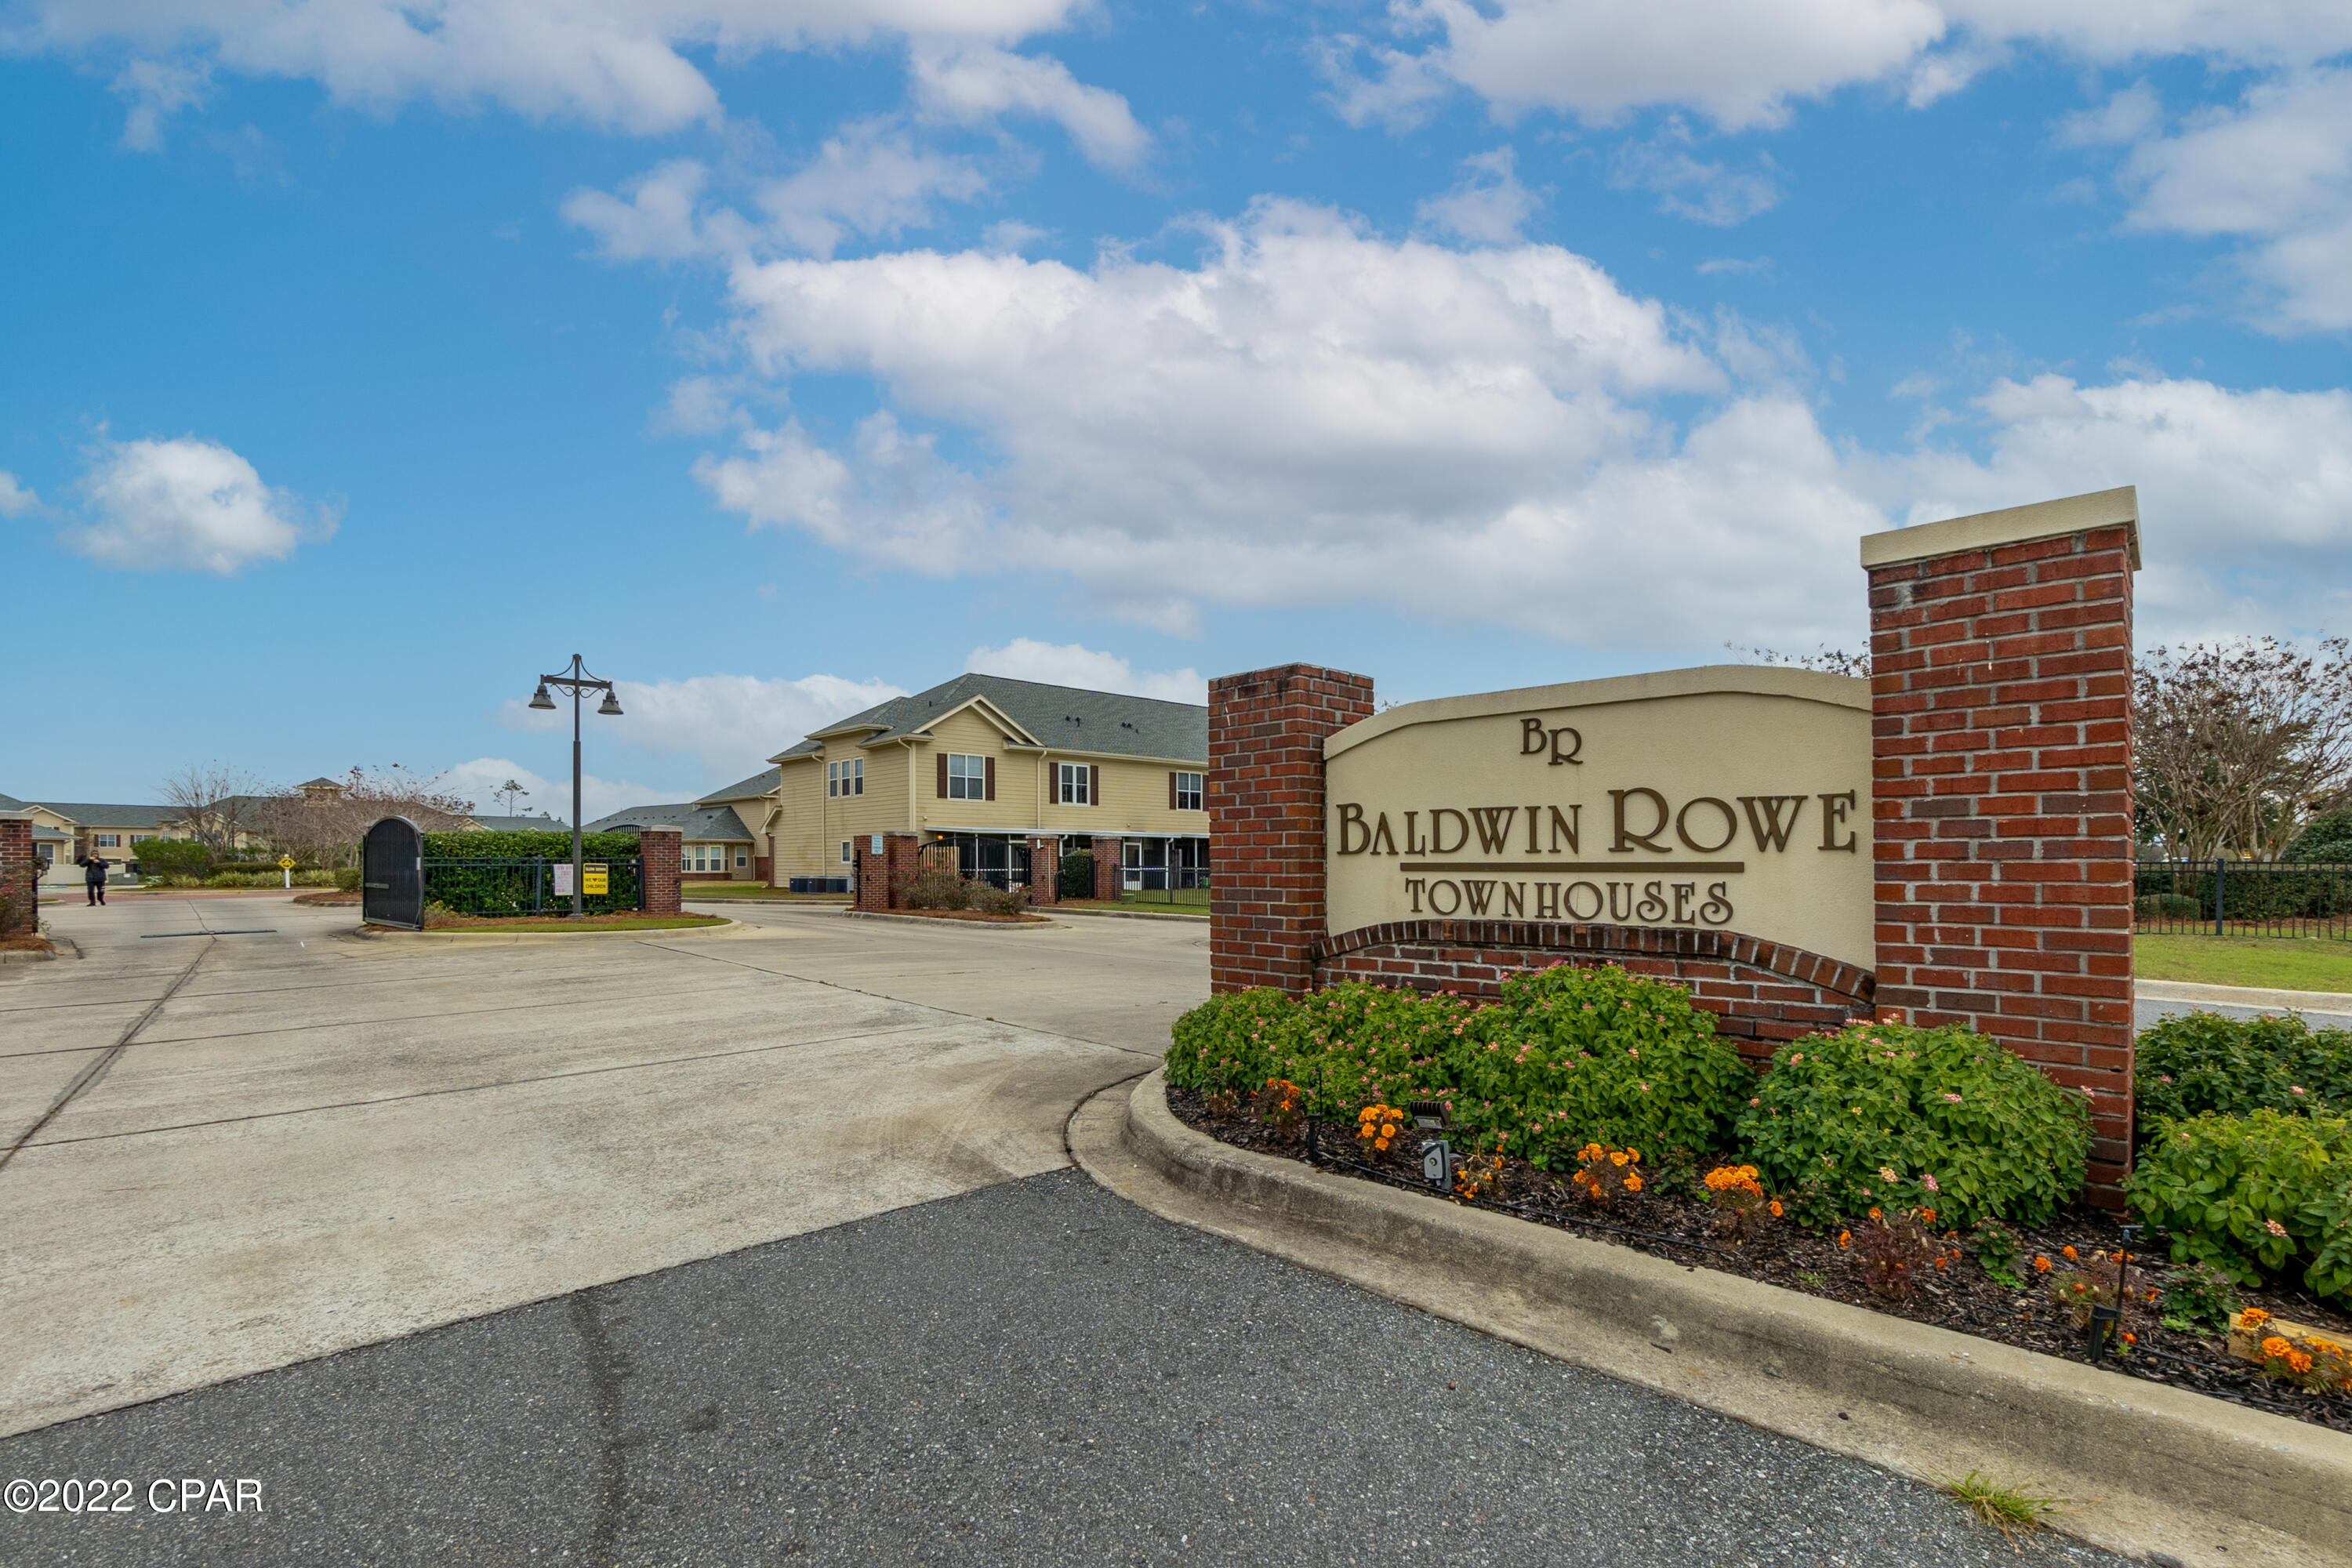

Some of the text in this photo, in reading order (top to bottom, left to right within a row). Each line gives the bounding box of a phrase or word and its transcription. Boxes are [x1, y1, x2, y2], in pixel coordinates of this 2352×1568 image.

[1335, 786, 1858, 858] BALDWIN ROWE
[1405, 877, 1735, 927] TOWNHOUSES
